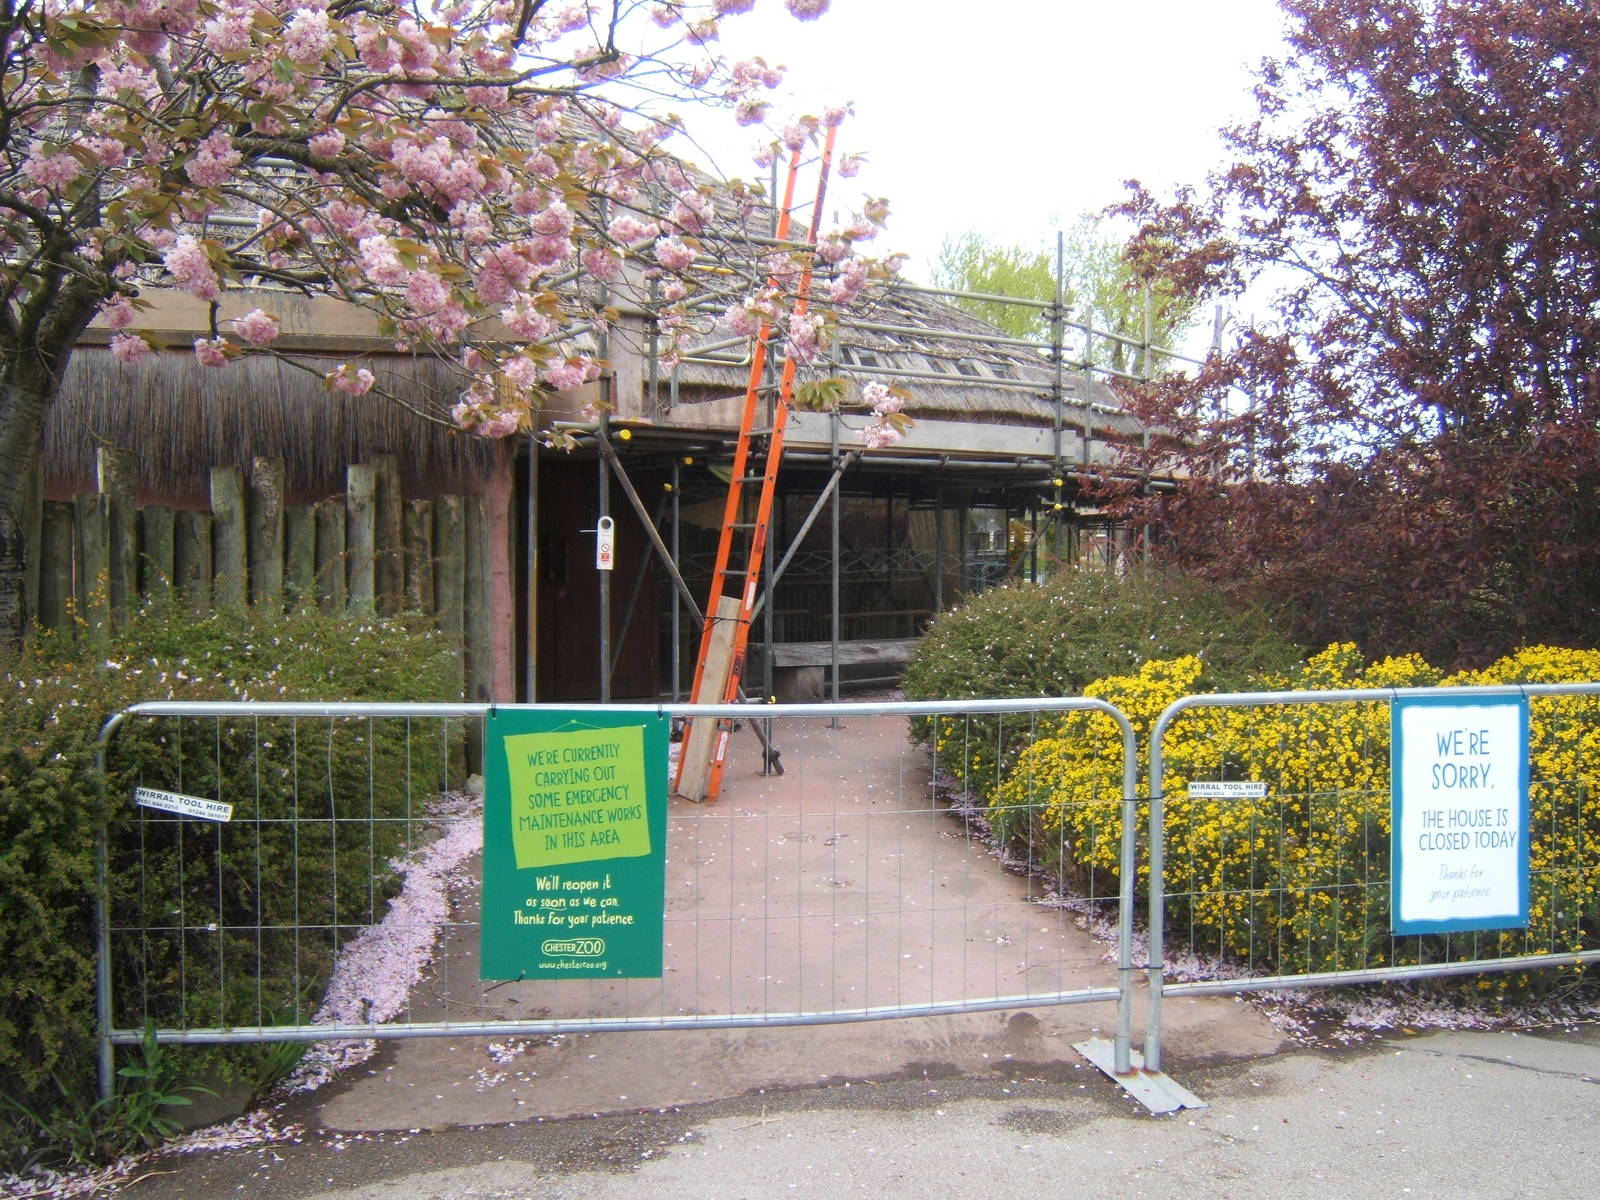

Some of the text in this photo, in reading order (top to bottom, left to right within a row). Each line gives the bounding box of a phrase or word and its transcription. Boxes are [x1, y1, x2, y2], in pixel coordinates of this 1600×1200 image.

[1436, 728, 1490, 757] WE'RE
[562, 743, 620, 764] CURRENTLY
[534, 765, 617, 788] CARRYING OUT
[1190, 783, 1263, 791] WIRRAL TOOL HIRE
[137, 788, 230, 814] WIRRAL TOOL HIRE
[528, 784, 629, 810] SOME EMERGENCY
[519, 805, 643, 831] MAINTENANCE WORKS
[1422, 808, 1508, 829] THE HOUSE IS
[545, 828, 621, 851] IN THIS AREA
[1419, 830, 1517, 851] CLOSED TODAY
[1439, 863, 1485, 881] Thanks for
[535, 873, 612, 894] We'll reopen it
[526, 898, 537, 907] as
[540, 898, 566, 909] soon
[569, 898, 580, 907] as
[583, 896, 597, 908] we
[1428, 887, 1451, 904] your
[514, 909, 545, 925] Thanks
[547, 911, 565, 925] for
[568, 914, 589, 929] your
[544, 940, 602, 955] CHESTER ZOO
[538, 958, 607, 971] www.chesterzoo.org
